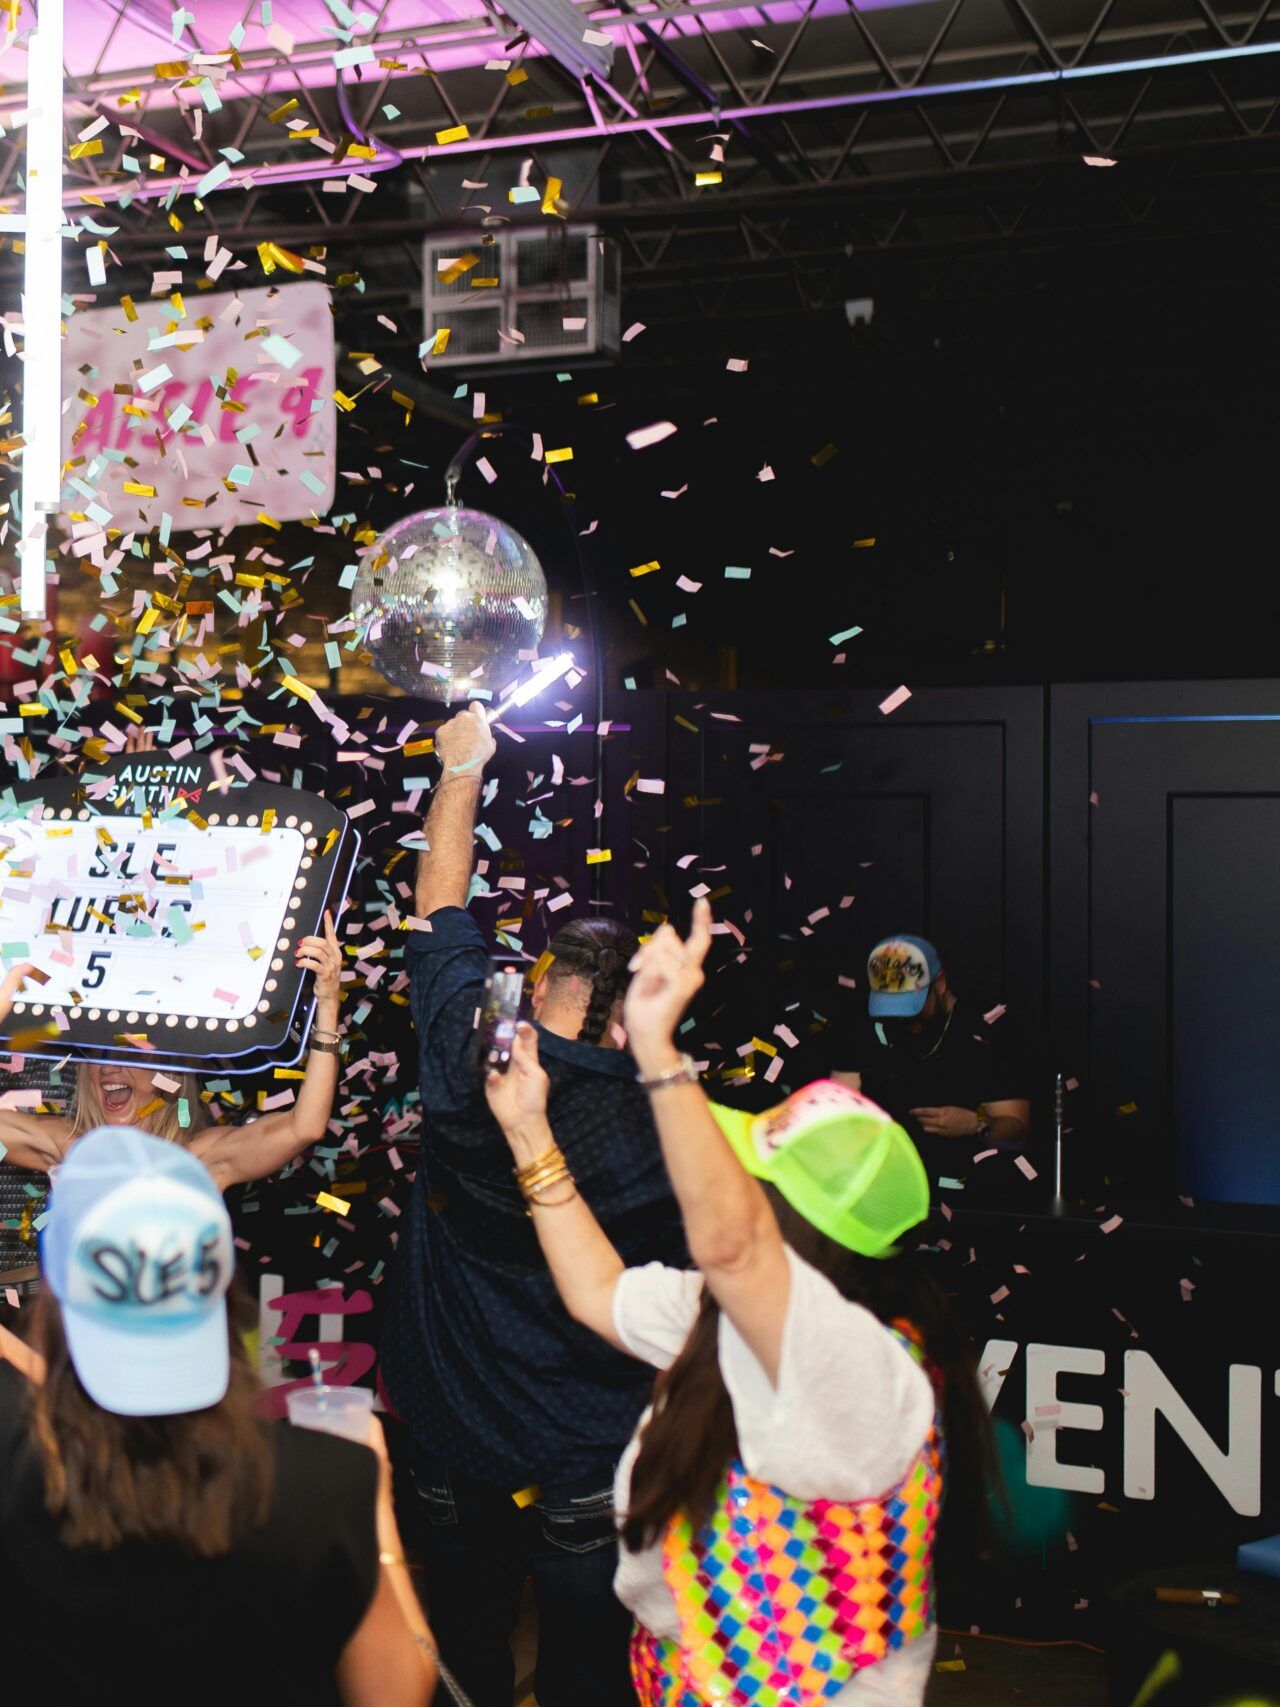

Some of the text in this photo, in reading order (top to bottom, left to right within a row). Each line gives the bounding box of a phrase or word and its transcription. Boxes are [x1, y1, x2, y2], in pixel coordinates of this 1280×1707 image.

[119, 764, 201, 784] AUSTIN
[89, 842, 177, 882] SLE
[81, 951, 112, 989] 5
